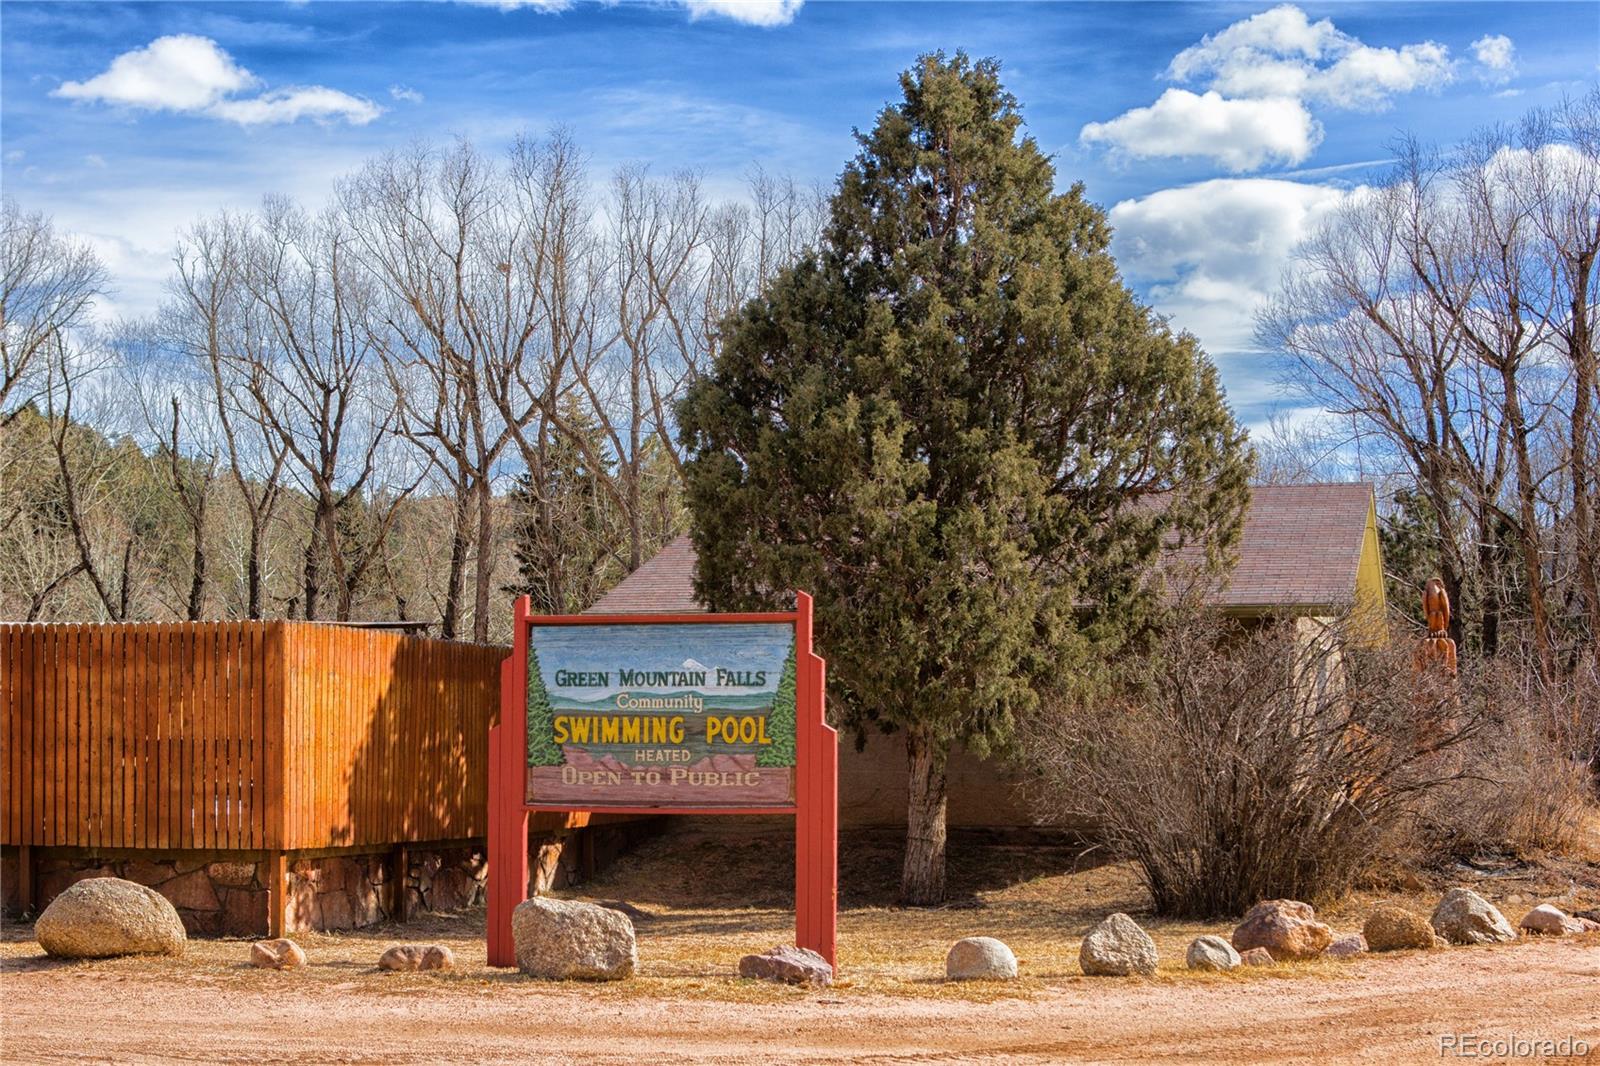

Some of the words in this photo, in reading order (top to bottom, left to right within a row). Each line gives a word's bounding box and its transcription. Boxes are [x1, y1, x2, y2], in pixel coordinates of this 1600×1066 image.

[555, 669, 608, 687] GREEN
[619, 669, 706, 687] MOUNTAIN
[716, 669, 766, 687] FALLS
[616, 693, 703, 713] Community
[553, 716, 685, 744] SWIMMING
[706, 716, 771, 744] POOL
[635, 749, 690, 762] HEATED
[562, 766, 622, 786] OPEN
[631, 768, 659, 786] TO
[670, 768, 760, 786] PUBLIC
